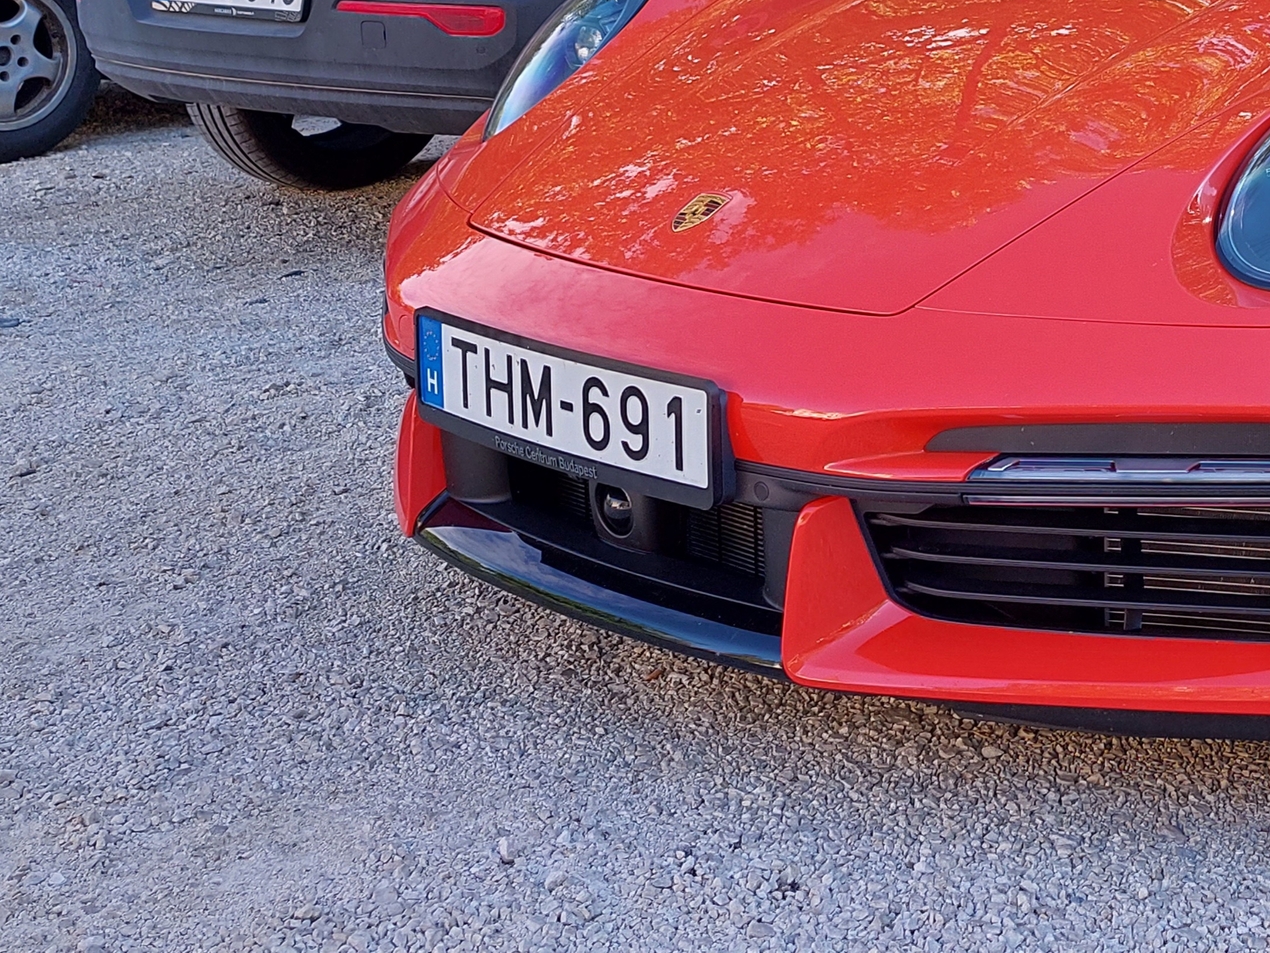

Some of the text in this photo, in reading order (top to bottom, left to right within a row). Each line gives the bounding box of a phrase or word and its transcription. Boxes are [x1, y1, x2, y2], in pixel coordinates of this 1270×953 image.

[426, 367, 439, 395] H
[450, 336, 684, 472] THM-691
[494, 435, 598, 479] Porsche Centrum Budapest
